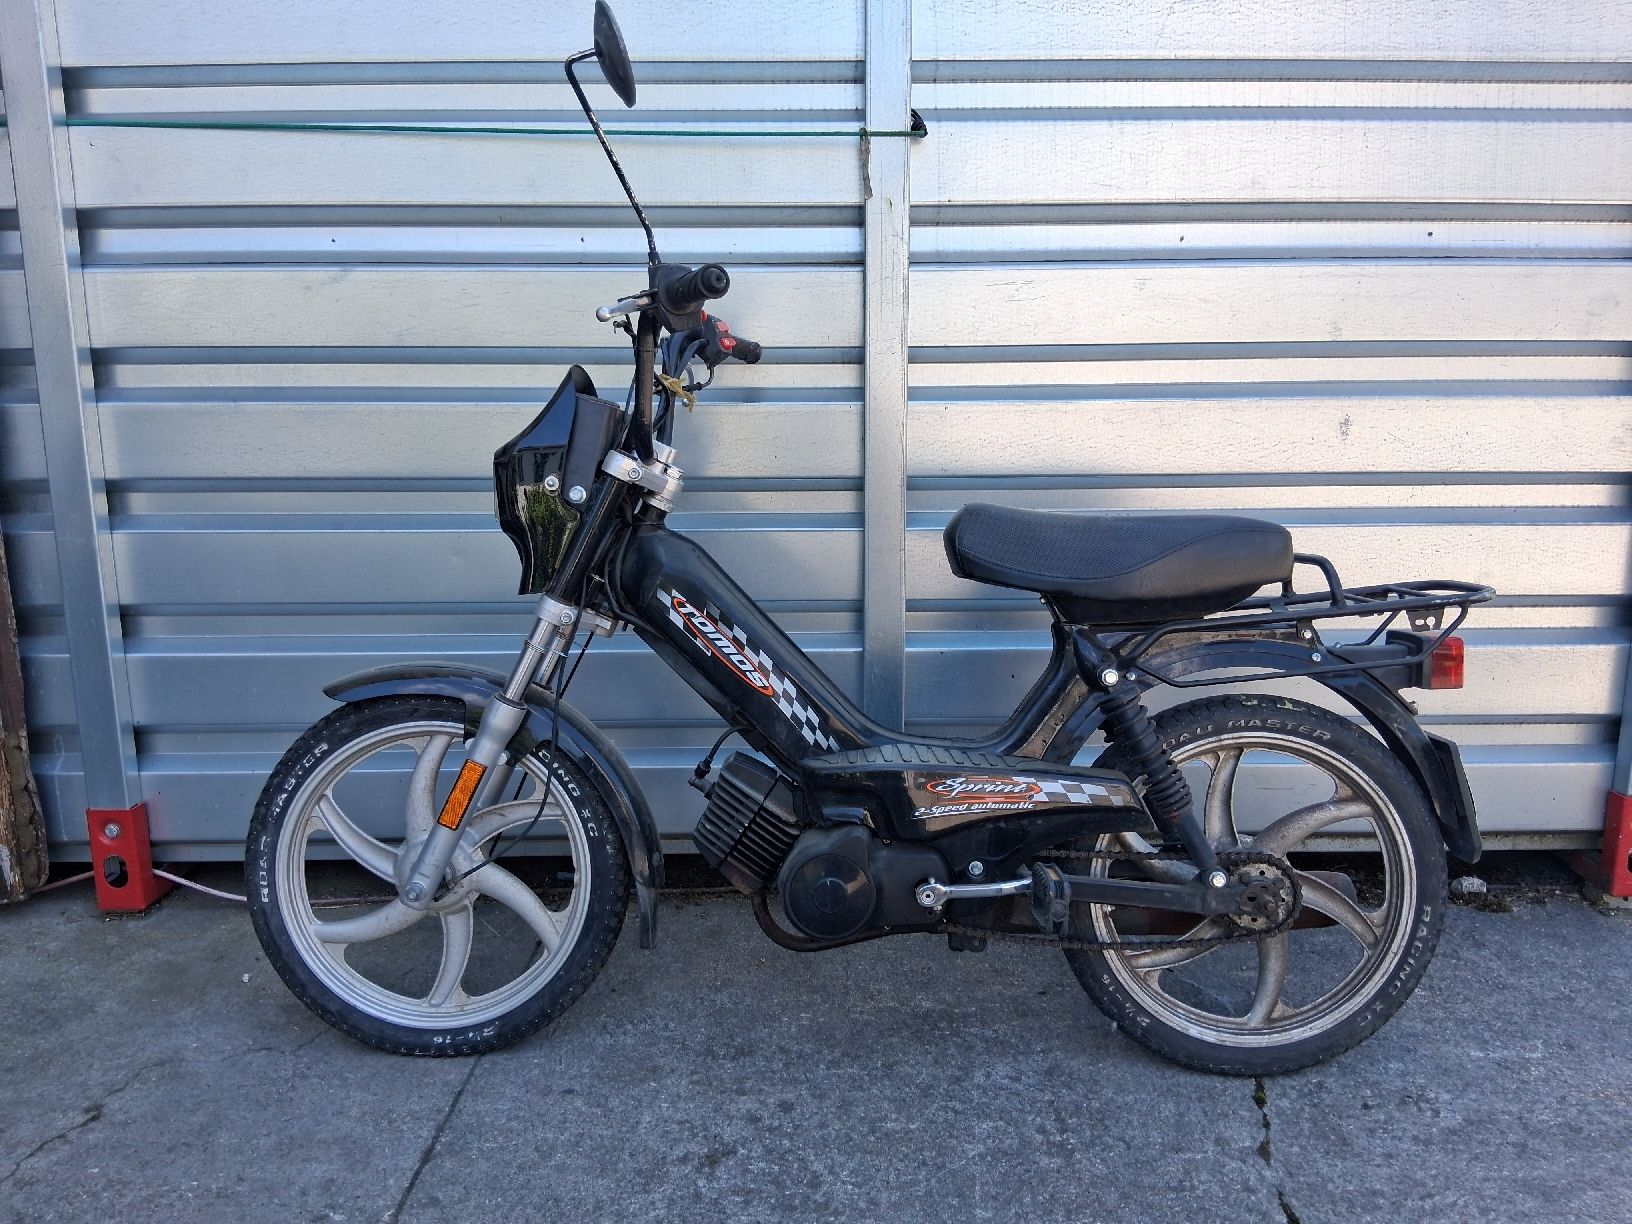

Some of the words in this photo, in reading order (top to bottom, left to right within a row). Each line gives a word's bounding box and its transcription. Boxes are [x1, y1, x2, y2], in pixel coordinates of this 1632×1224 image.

[1227, 718, 1332, 742] MASTER
[936, 777, 1028, 799] Sprint
[914, 803, 968, 818] 2-Speed
[970, 800, 1036, 812] automatic
[1391, 906, 1432, 996] RACING
